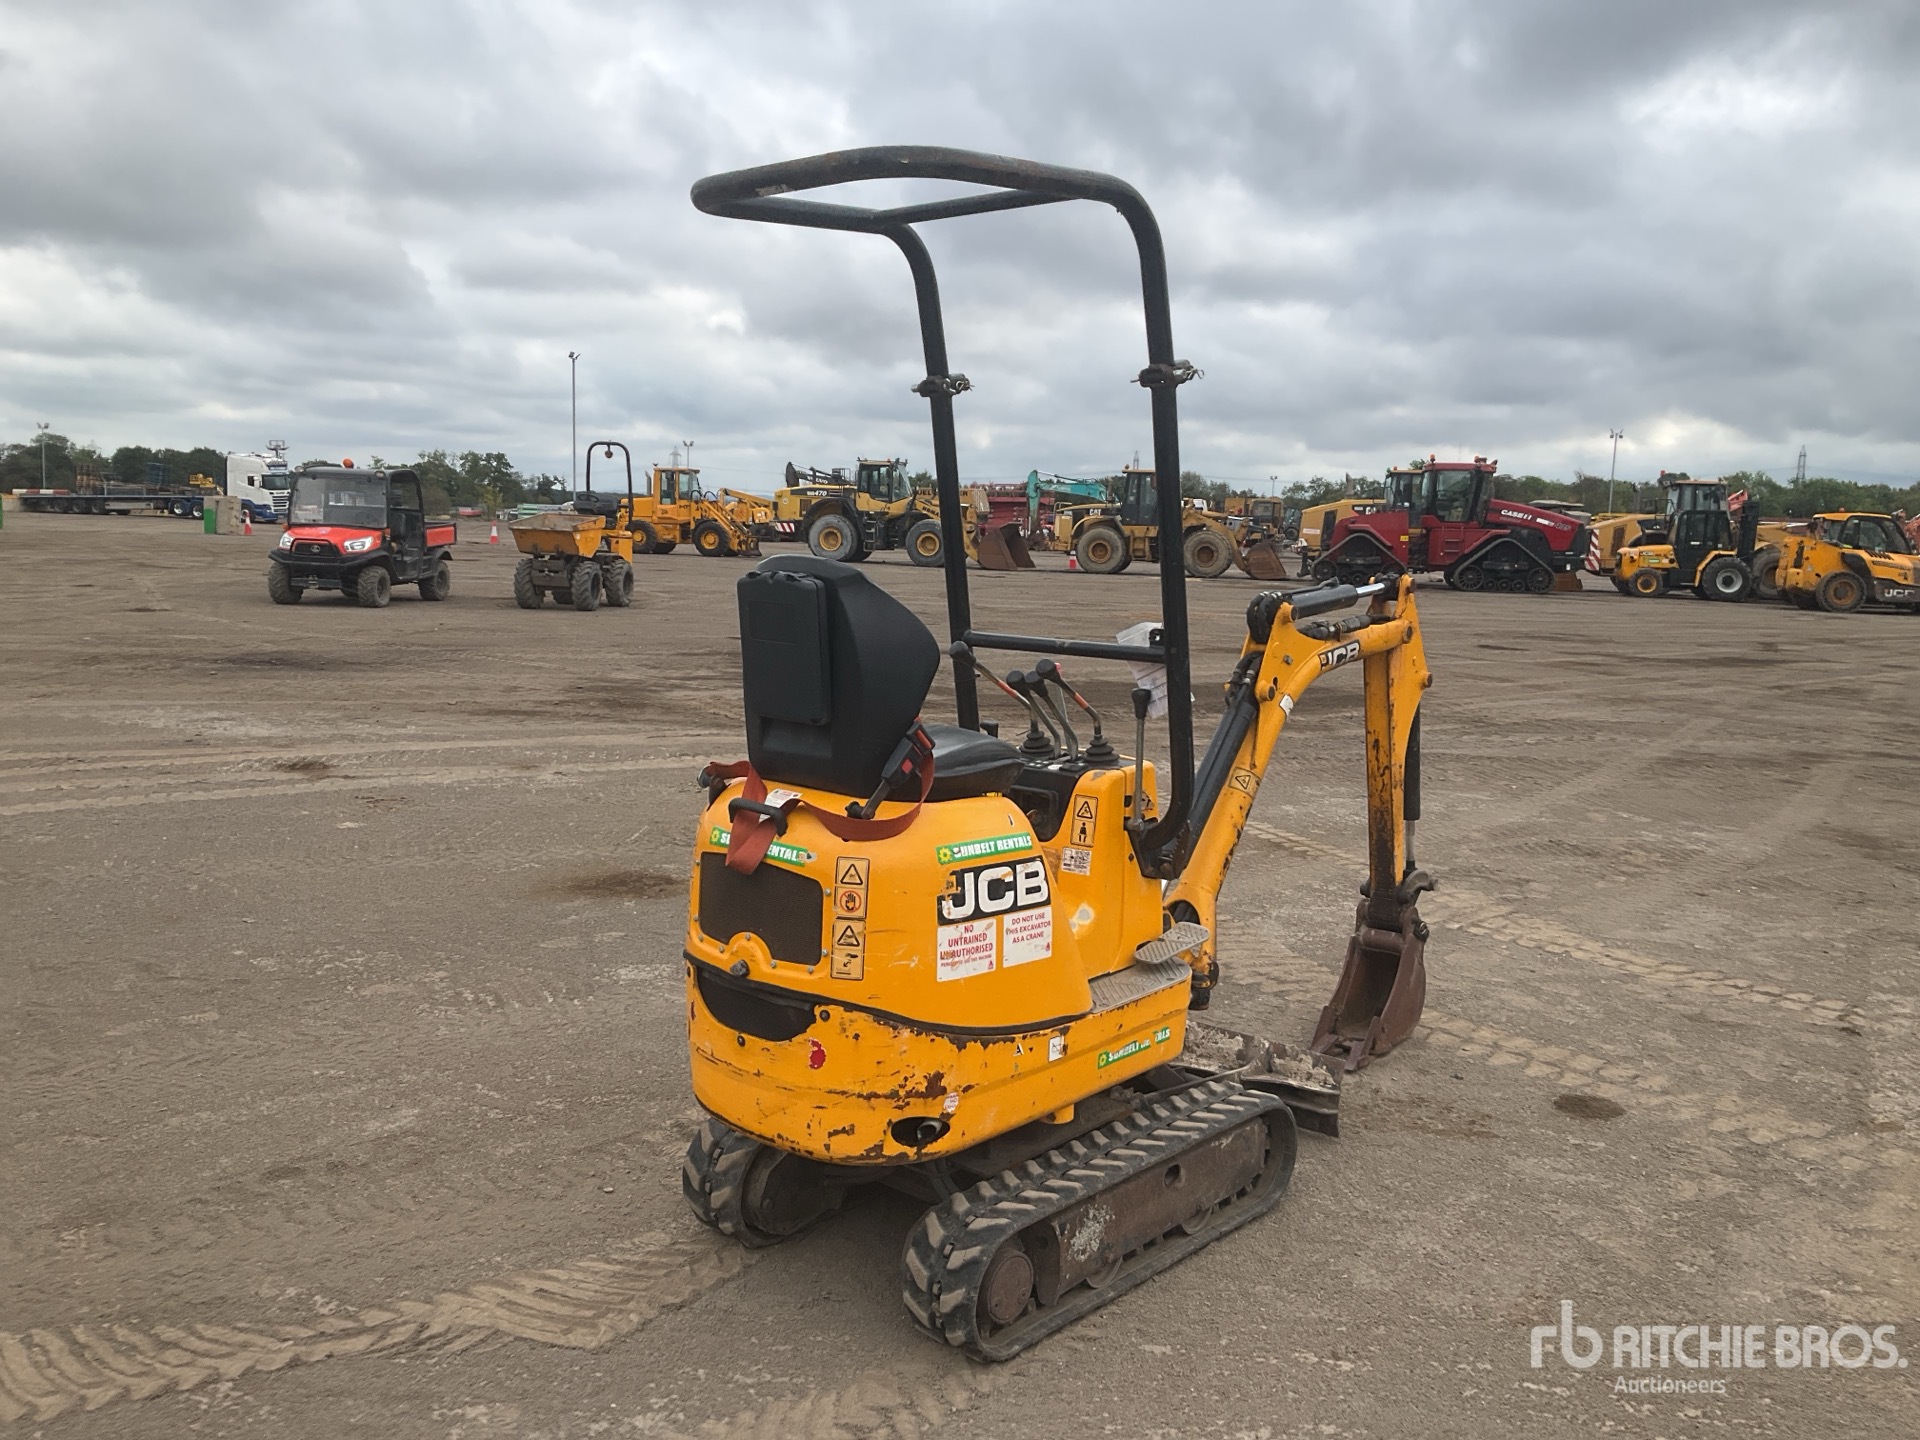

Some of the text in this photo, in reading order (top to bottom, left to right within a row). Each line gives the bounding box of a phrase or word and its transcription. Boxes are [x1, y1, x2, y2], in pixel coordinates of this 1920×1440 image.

[1089, 508, 1102, 516] CAT
[767, 844, 806, 863] ENTAL
[952, 835, 1033, 858] SUNBELT RENTALS
[941, 858, 1049, 920] JCB
[1011, 912, 1046, 926] DO NOT USE
[963, 924, 974, 934] NO
[1019, 920, 1052, 933] EXCAVATOR
[947, 932, 988, 948] UNTRAINED
[1025, 931, 1045, 941] CRANE
